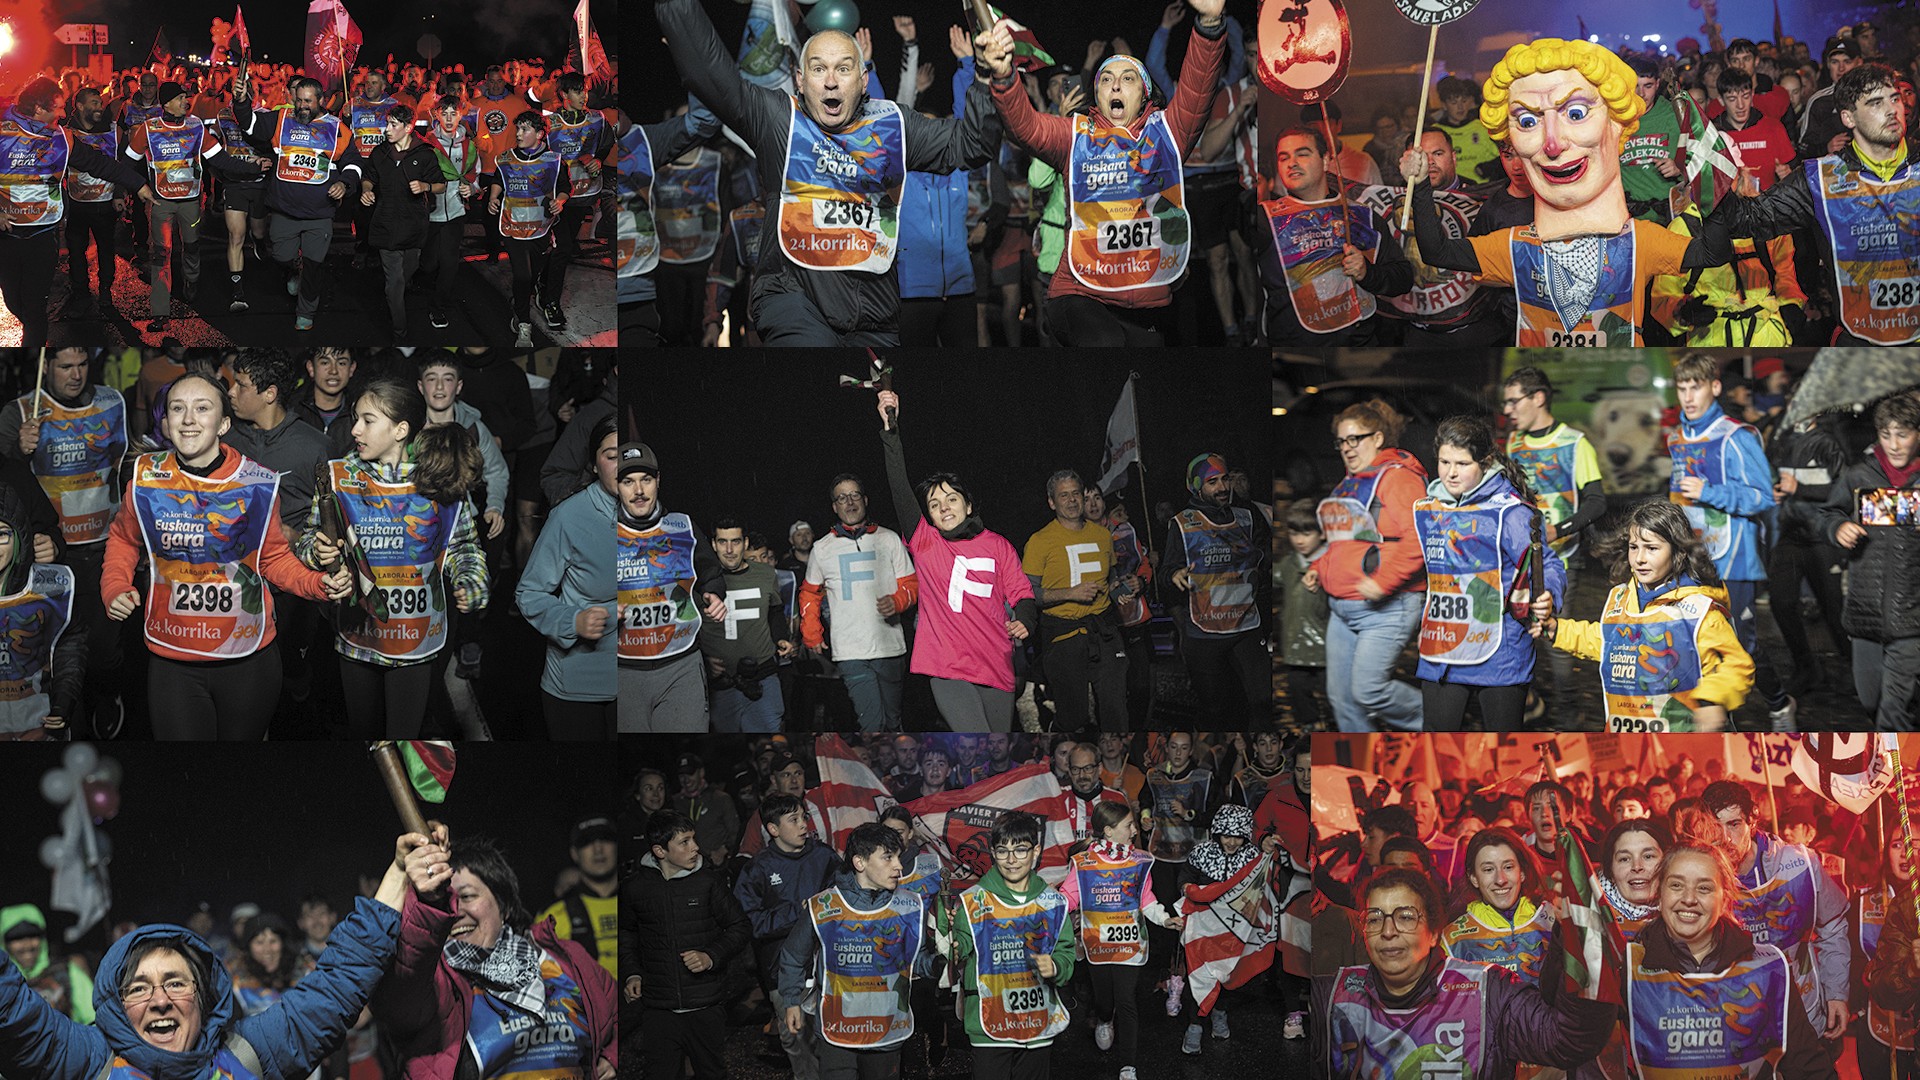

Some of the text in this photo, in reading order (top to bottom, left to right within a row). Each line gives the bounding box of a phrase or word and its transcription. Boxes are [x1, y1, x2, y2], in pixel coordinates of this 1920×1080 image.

[359, 116, 376, 124] gara
[290, 133, 310, 142] gara
[363, 134, 384, 145] 2348
[161, 147, 181, 157] gara
[561, 146, 581, 156] gara
[811, 141, 857, 164] Euskara
[10, 158, 36, 169] gara
[292, 154, 317, 168] 2349
[815, 156, 858, 178] gara
[1081, 160, 1127, 173] Euskara
[508, 183, 529, 192] gara
[1086, 170, 1128, 191] gara
[823, 199, 874, 229] 2367
[1106, 221, 1153, 250] 2367
[1292, 229, 1332, 245] Euskara
[1850, 223, 1897, 236] Euskara
[790, 233, 869, 252] 24.korrika
[1299, 237, 1334, 256] gara
[1857, 233, 1898, 251] gara
[1077, 257, 1150, 276] 24.korrika
[1159, 250, 1180, 271] aek
[1852, 312, 1919, 330] 24.korrika
[1551, 331, 1597, 347] 2381
[47, 441, 86, 453] Euskara
[52, 450, 86, 467] gara
[62, 517, 103, 534] korrika
[155, 519, 204, 533] Euskara
[354, 523, 404, 535] Euskara
[670, 521, 687, 529] eitb
[160, 531, 205, 550] gara
[359, 535, 404, 553] gara
[617, 557, 647, 567] uskara
[1065, 542, 1102, 588] F
[1204, 553, 1232, 567] gara
[617, 565, 649, 582] gara
[838, 550, 877, 601] F
[948, 555, 996, 613] F
[175, 583, 233, 613] 2398
[632, 604, 671, 627] 2379
[725, 587, 762, 640] F
[1428, 594, 1468, 620] 338
[148, 618, 222, 639] 24.korrika
[232, 619, 261, 639] aek
[1466, 628, 1492, 643] aek
[1784, 858, 1806, 872] eitb
[1091, 886, 1121, 894] Euskara
[1095, 893, 1122, 905] gara
[1107, 925, 1139, 942] 2399
[833, 942, 872, 953] Euskara
[989, 940, 1024, 951] Euskara
[1089, 946, 1133, 955] 24.korrika
[837, 951, 873, 966] gara
[992, 948, 1025, 965] gara
[1008, 987, 1045, 1011] 2399
[1666, 1005, 1706, 1015] 24.korrika
[825, 1020, 884, 1034] 24.korrika
[1658, 1014, 1722, 1031] Euskara
[514, 1024, 576, 1055] gara
[1667, 1029, 1724, 1054] gara
